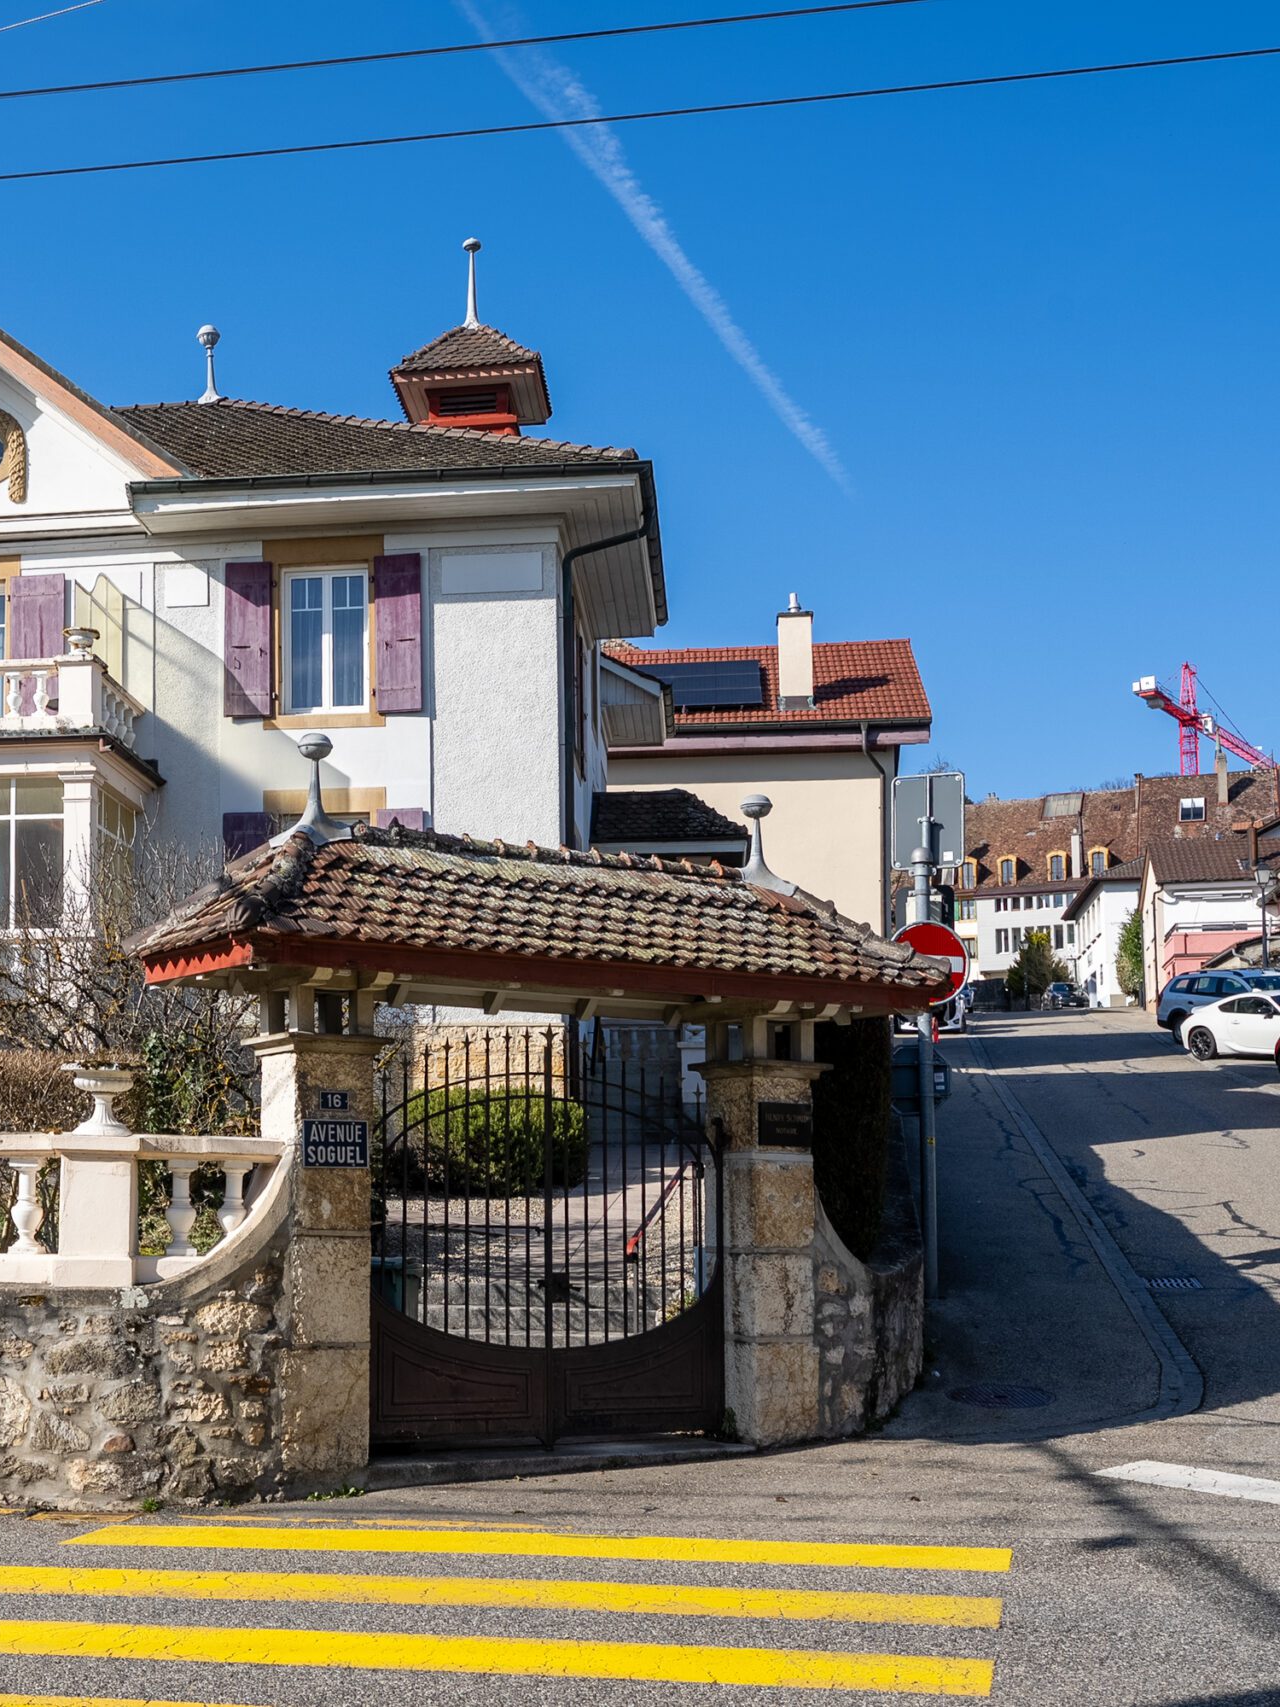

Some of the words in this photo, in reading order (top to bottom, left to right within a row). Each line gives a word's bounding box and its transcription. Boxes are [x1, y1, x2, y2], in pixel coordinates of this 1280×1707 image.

[327, 1094, 342, 1108] 16
[309, 1124, 363, 1143] AVENUE
[307, 1146, 365, 1164] SOGUEL
